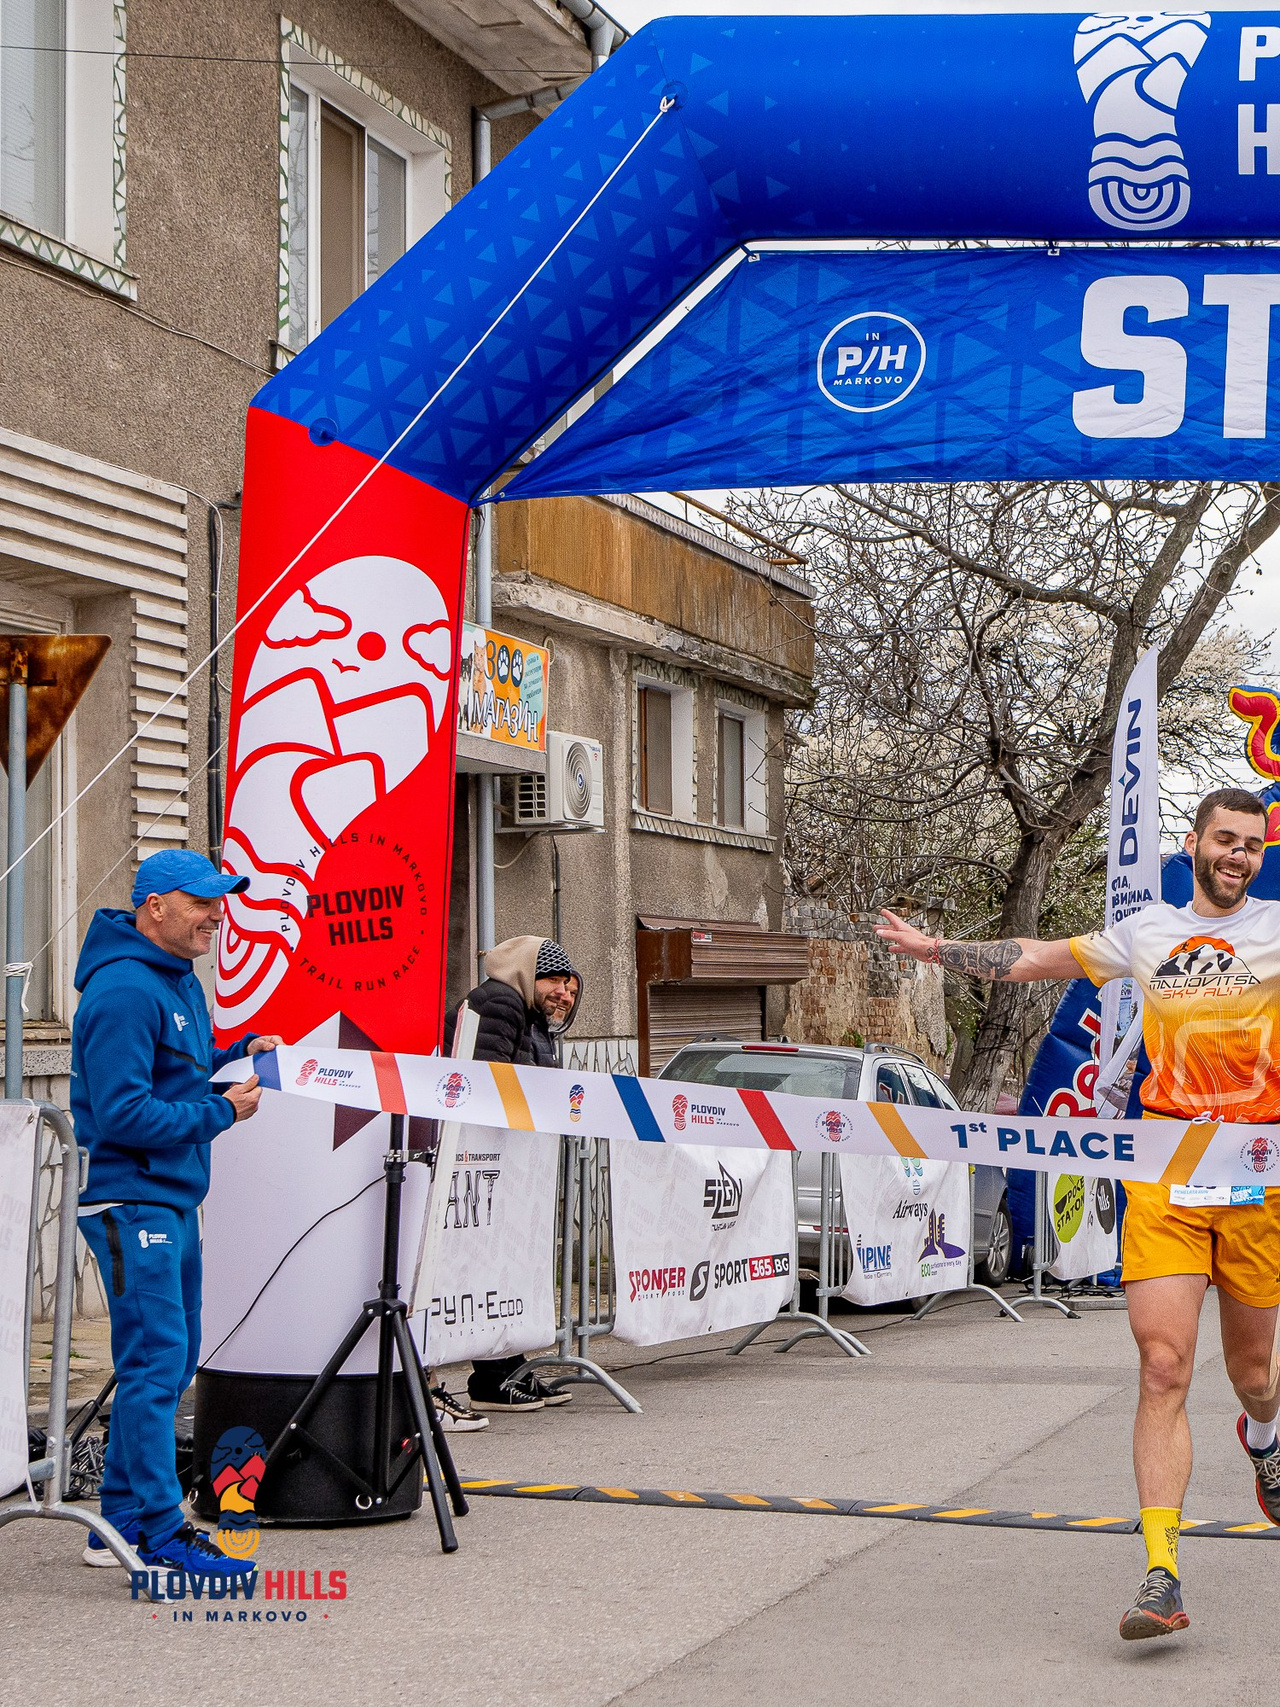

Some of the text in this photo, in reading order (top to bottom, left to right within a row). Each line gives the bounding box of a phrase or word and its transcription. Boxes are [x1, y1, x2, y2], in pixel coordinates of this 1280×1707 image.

[865, 332, 880, 341] IN
[836, 345, 908, 376] P/H
[833, 376, 903, 386] MARKOVO
[472, 690, 539, 742] МАГАЗИН
[1119, 698, 1142, 866] DEVIN
[280, 832, 428, 933] PLOVDIV HILLS IN MARKOVO
[306, 884, 404, 919] PLOVDIV
[328, 916, 394, 946] HILLS
[300, 946, 421, 992] TRAIL RUN RACE
[314, 1076, 339, 1086] HILLS
[318, 1067, 354, 1079] PLOVDIV
[691, 1104, 726, 1116] PLOVDIV
[691, 1115, 715, 1125] HILLS
[950, 1122, 1135, 1162] 1st PLACE
[468, 1152, 501, 1163] TRANSPORT
[893, 1200, 928, 1221] Airways
[628, 1266, 686, 1303] SPONSER
